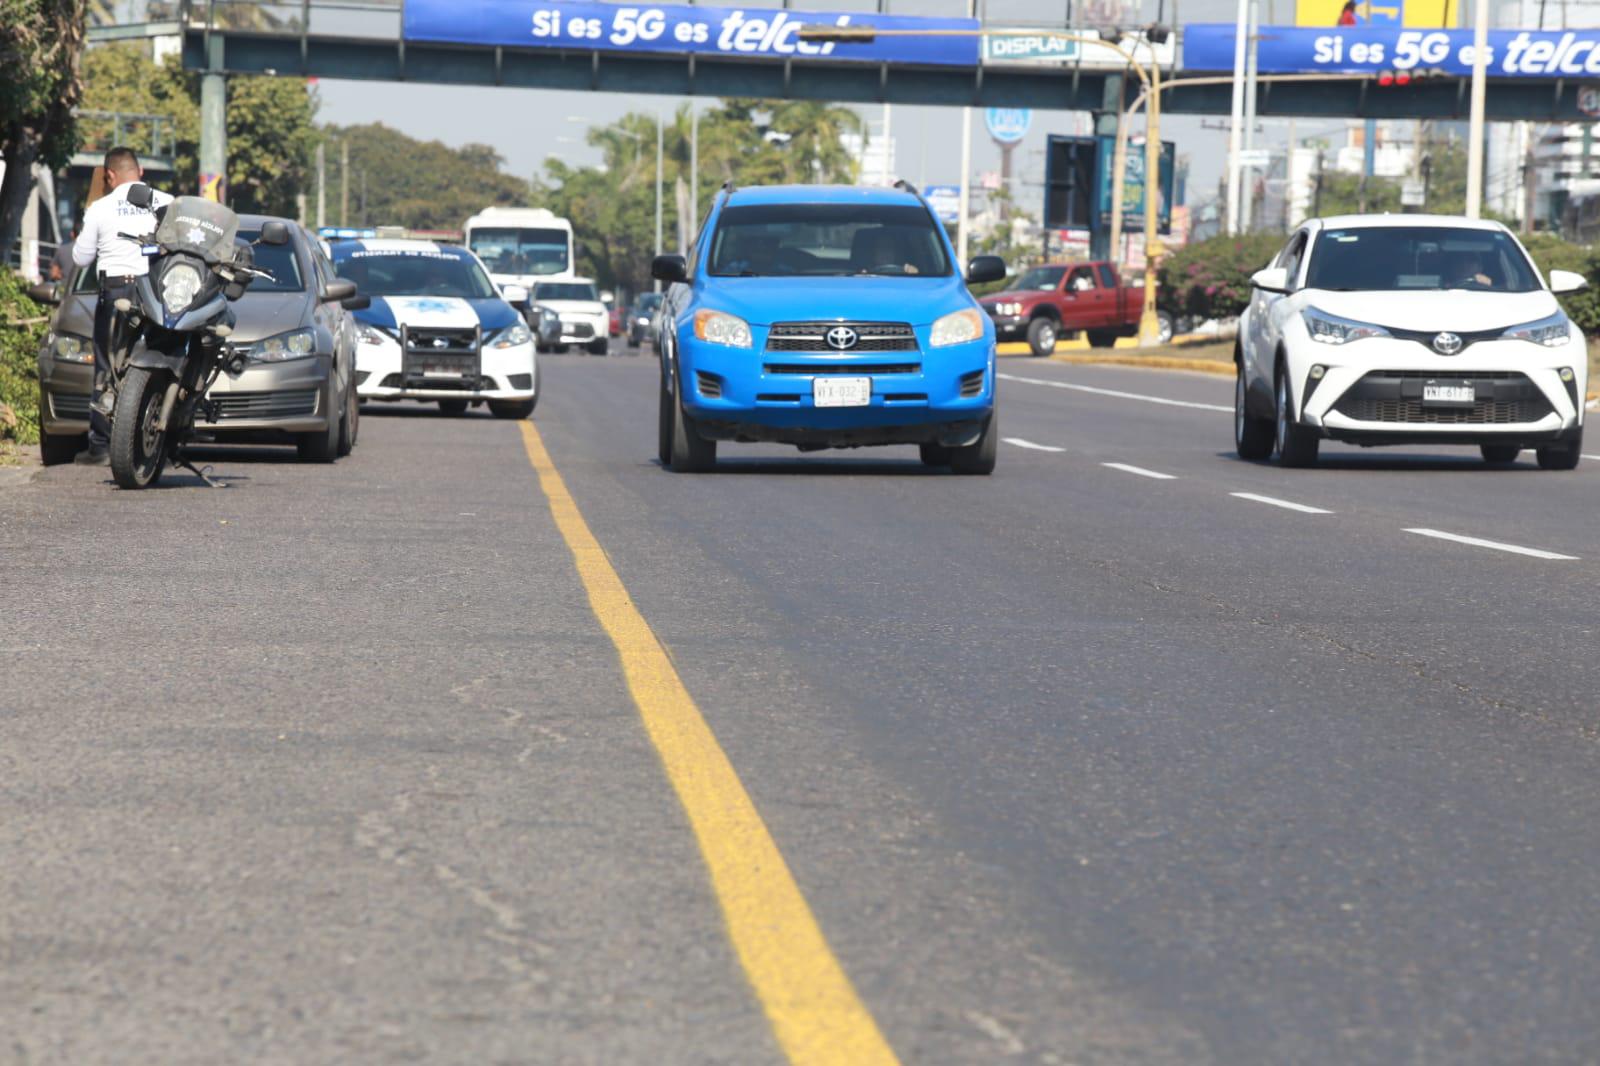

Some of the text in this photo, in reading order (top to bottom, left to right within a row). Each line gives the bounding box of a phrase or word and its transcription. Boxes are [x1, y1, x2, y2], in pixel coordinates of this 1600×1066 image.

[532, 10, 560, 37] Si
[568, 15, 601, 39] es
[610, 8, 665, 46] 5G
[674, 20, 709, 44] es
[992, 36, 1067, 55] DISPLAY
[1314, 36, 1343, 64] Si
[1349, 42, 1385, 65] es
[1393, 31, 1450, 69] 5G
